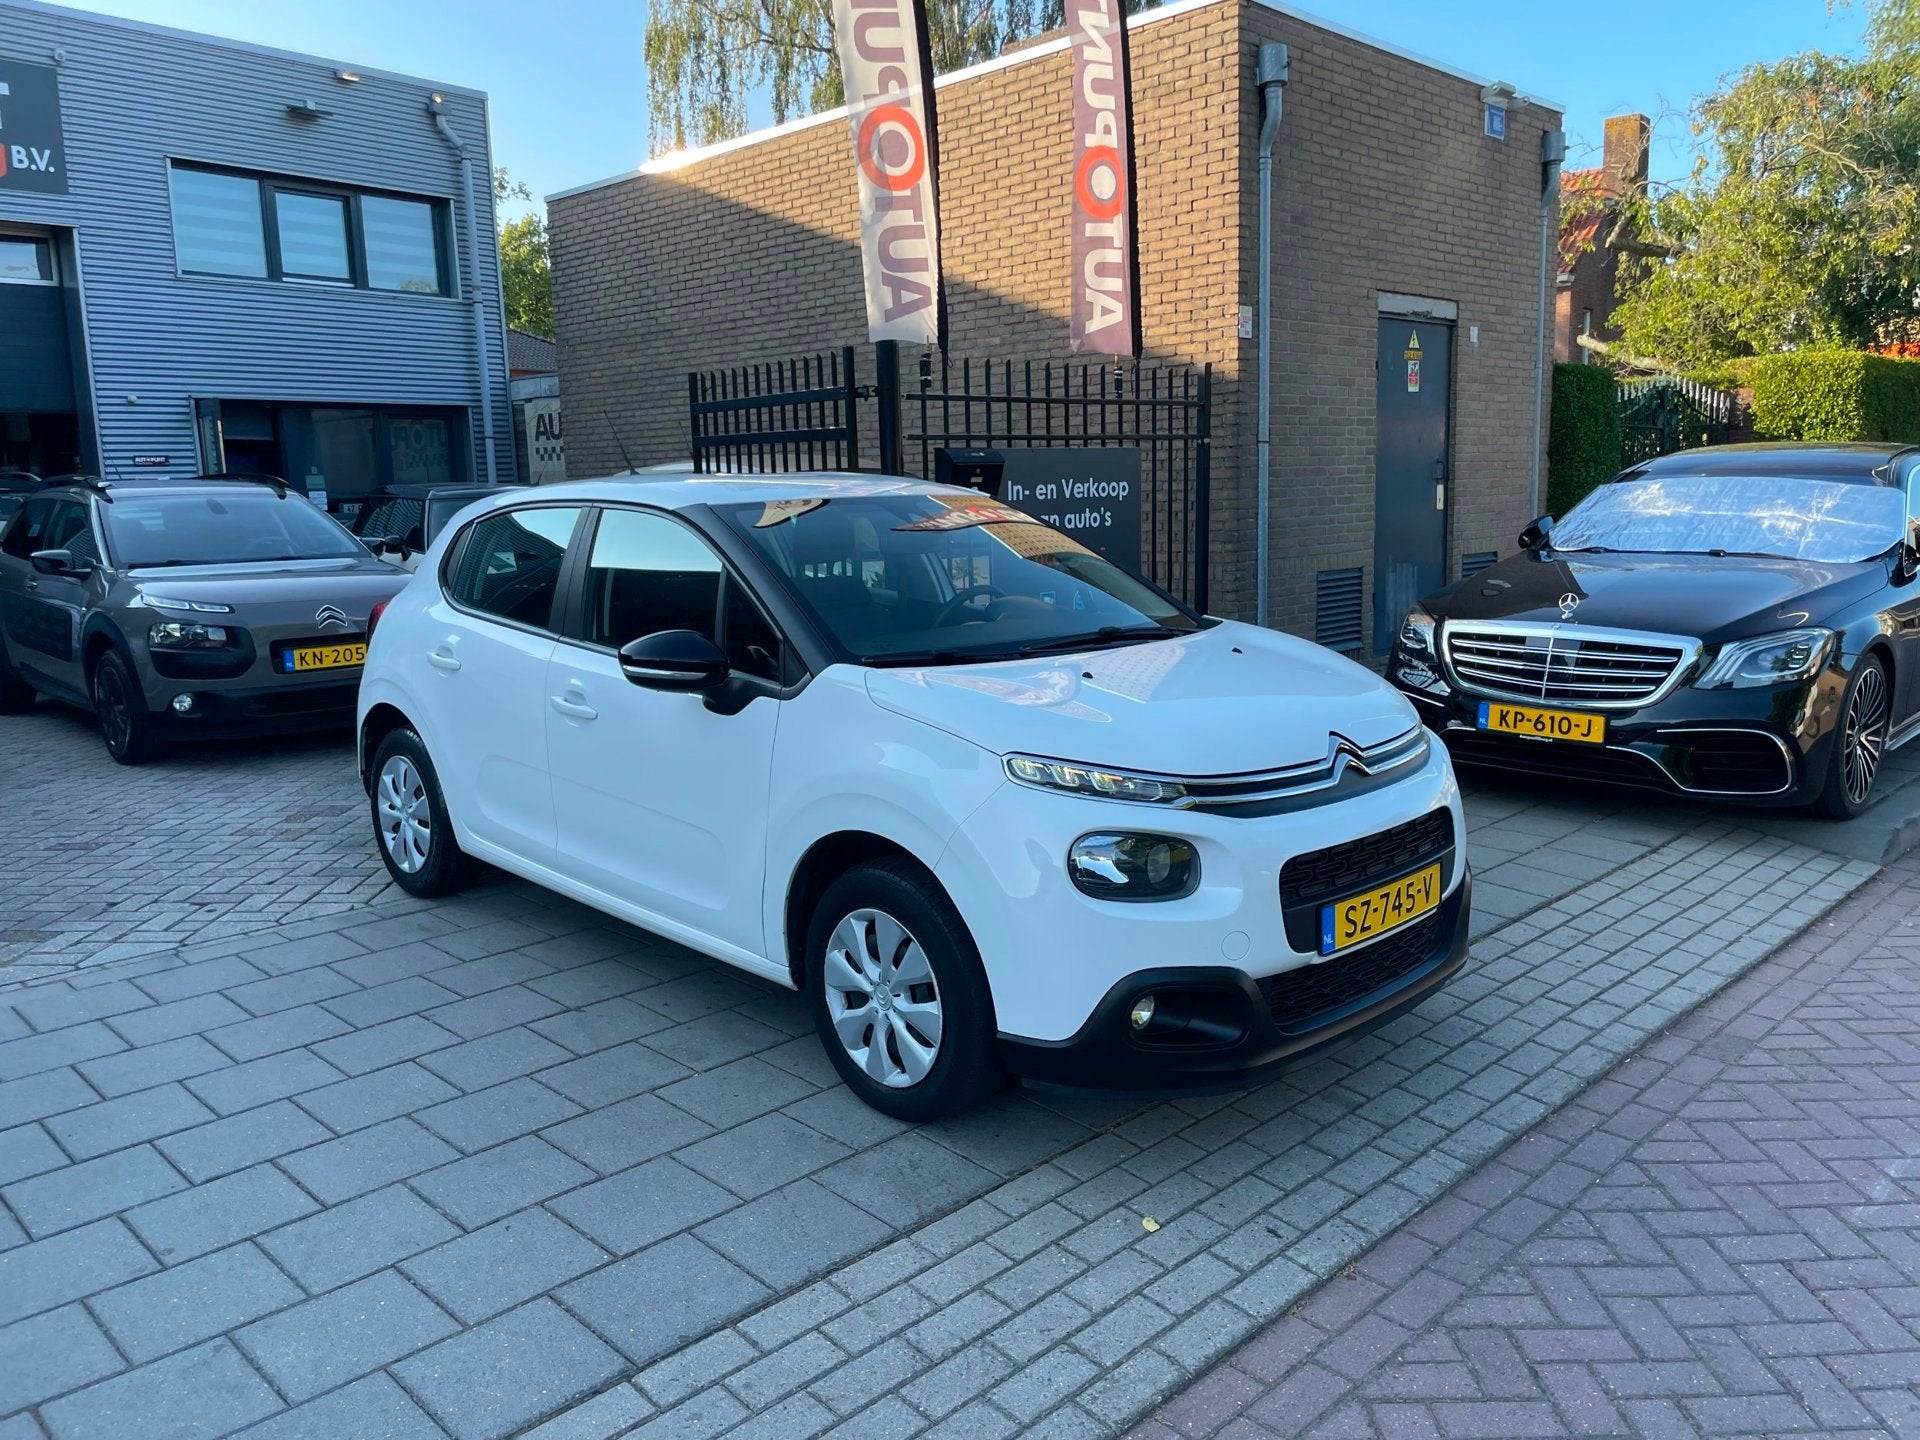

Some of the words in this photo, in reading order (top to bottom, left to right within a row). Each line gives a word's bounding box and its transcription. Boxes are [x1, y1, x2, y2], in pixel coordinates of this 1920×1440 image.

[10, 145, 55, 173] B.V.
[1007, 480, 1030, 501] In-
[1035, 483, 1057, 500] en
[1061, 477, 1129, 501] Verkoop
[1064, 507, 1112, 529] auto's
[299, 646, 365, 667] KN-205
[1498, 708, 1592, 738] KP-610-J
[1323, 933, 1334, 945] NL
[1344, 872, 1433, 938] SZ-745-V
